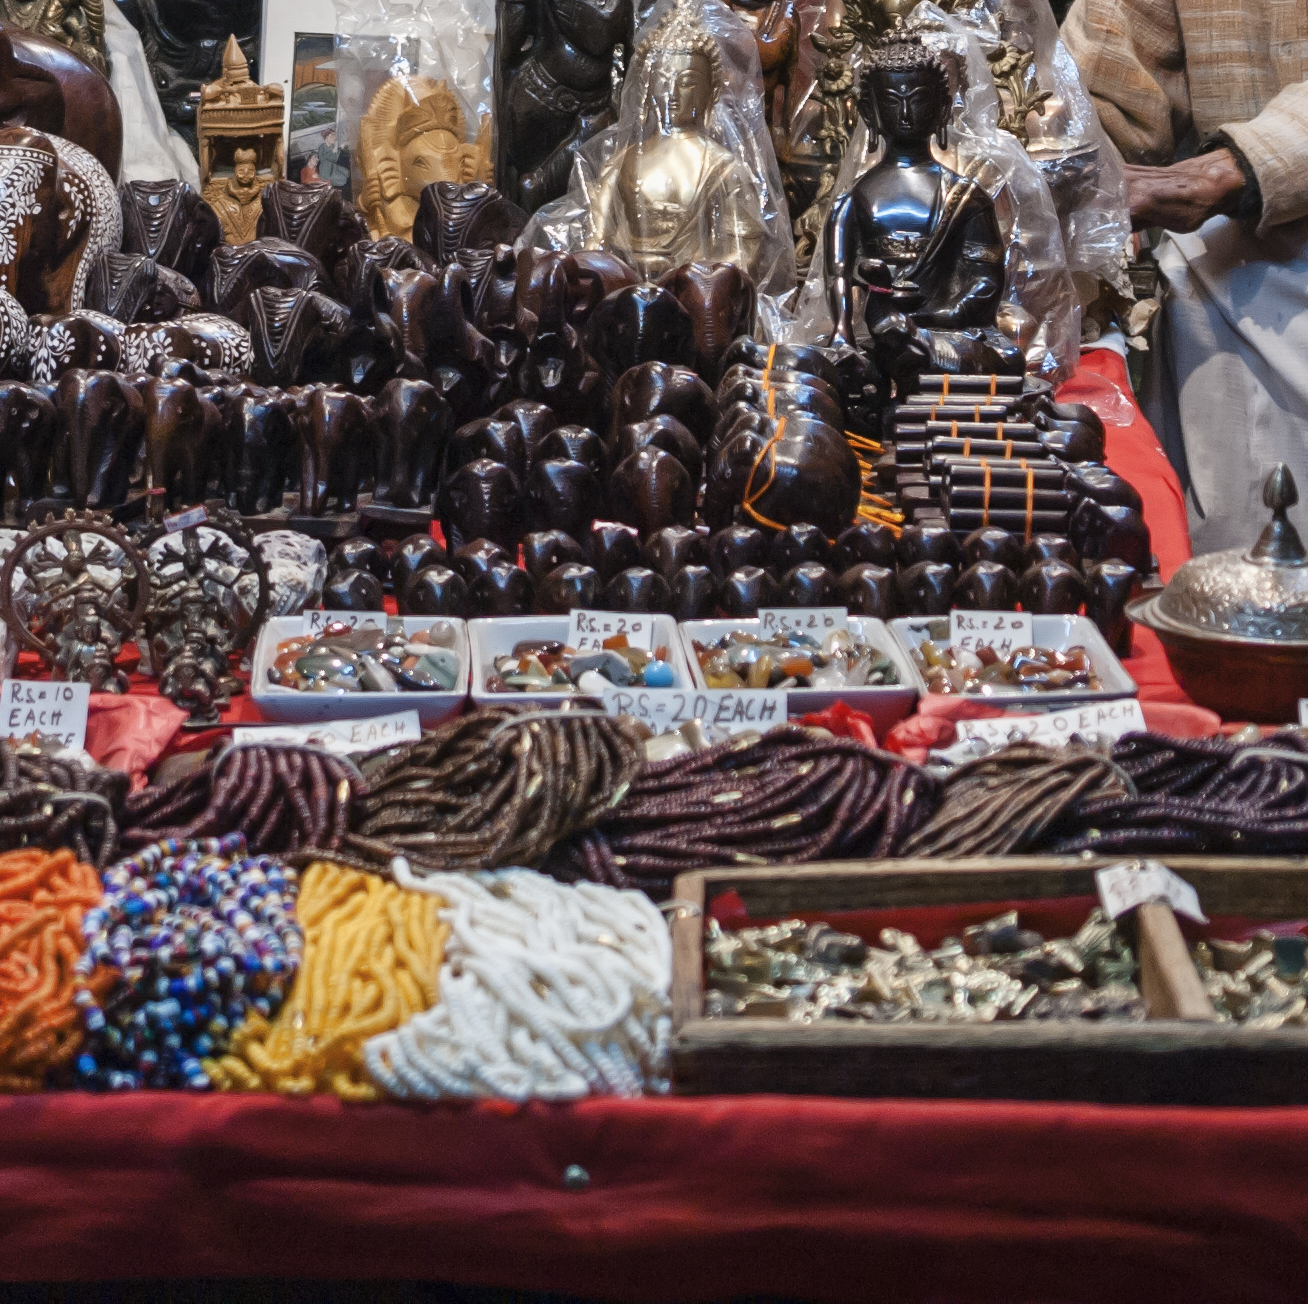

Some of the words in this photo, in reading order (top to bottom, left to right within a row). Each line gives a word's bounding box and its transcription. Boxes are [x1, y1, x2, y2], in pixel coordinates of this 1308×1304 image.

[616, 618, 643, 634] 20
[993, 616, 1024, 630] 20
[54, 686, 74, 702] 10
[8, 708, 63, 727] EACH
[671, 694, 707, 723] 20
[713, 692, 778, 724] EACH
[1077, 703, 1135, 730] EACH
[348, 720, 407, 744] EACH
